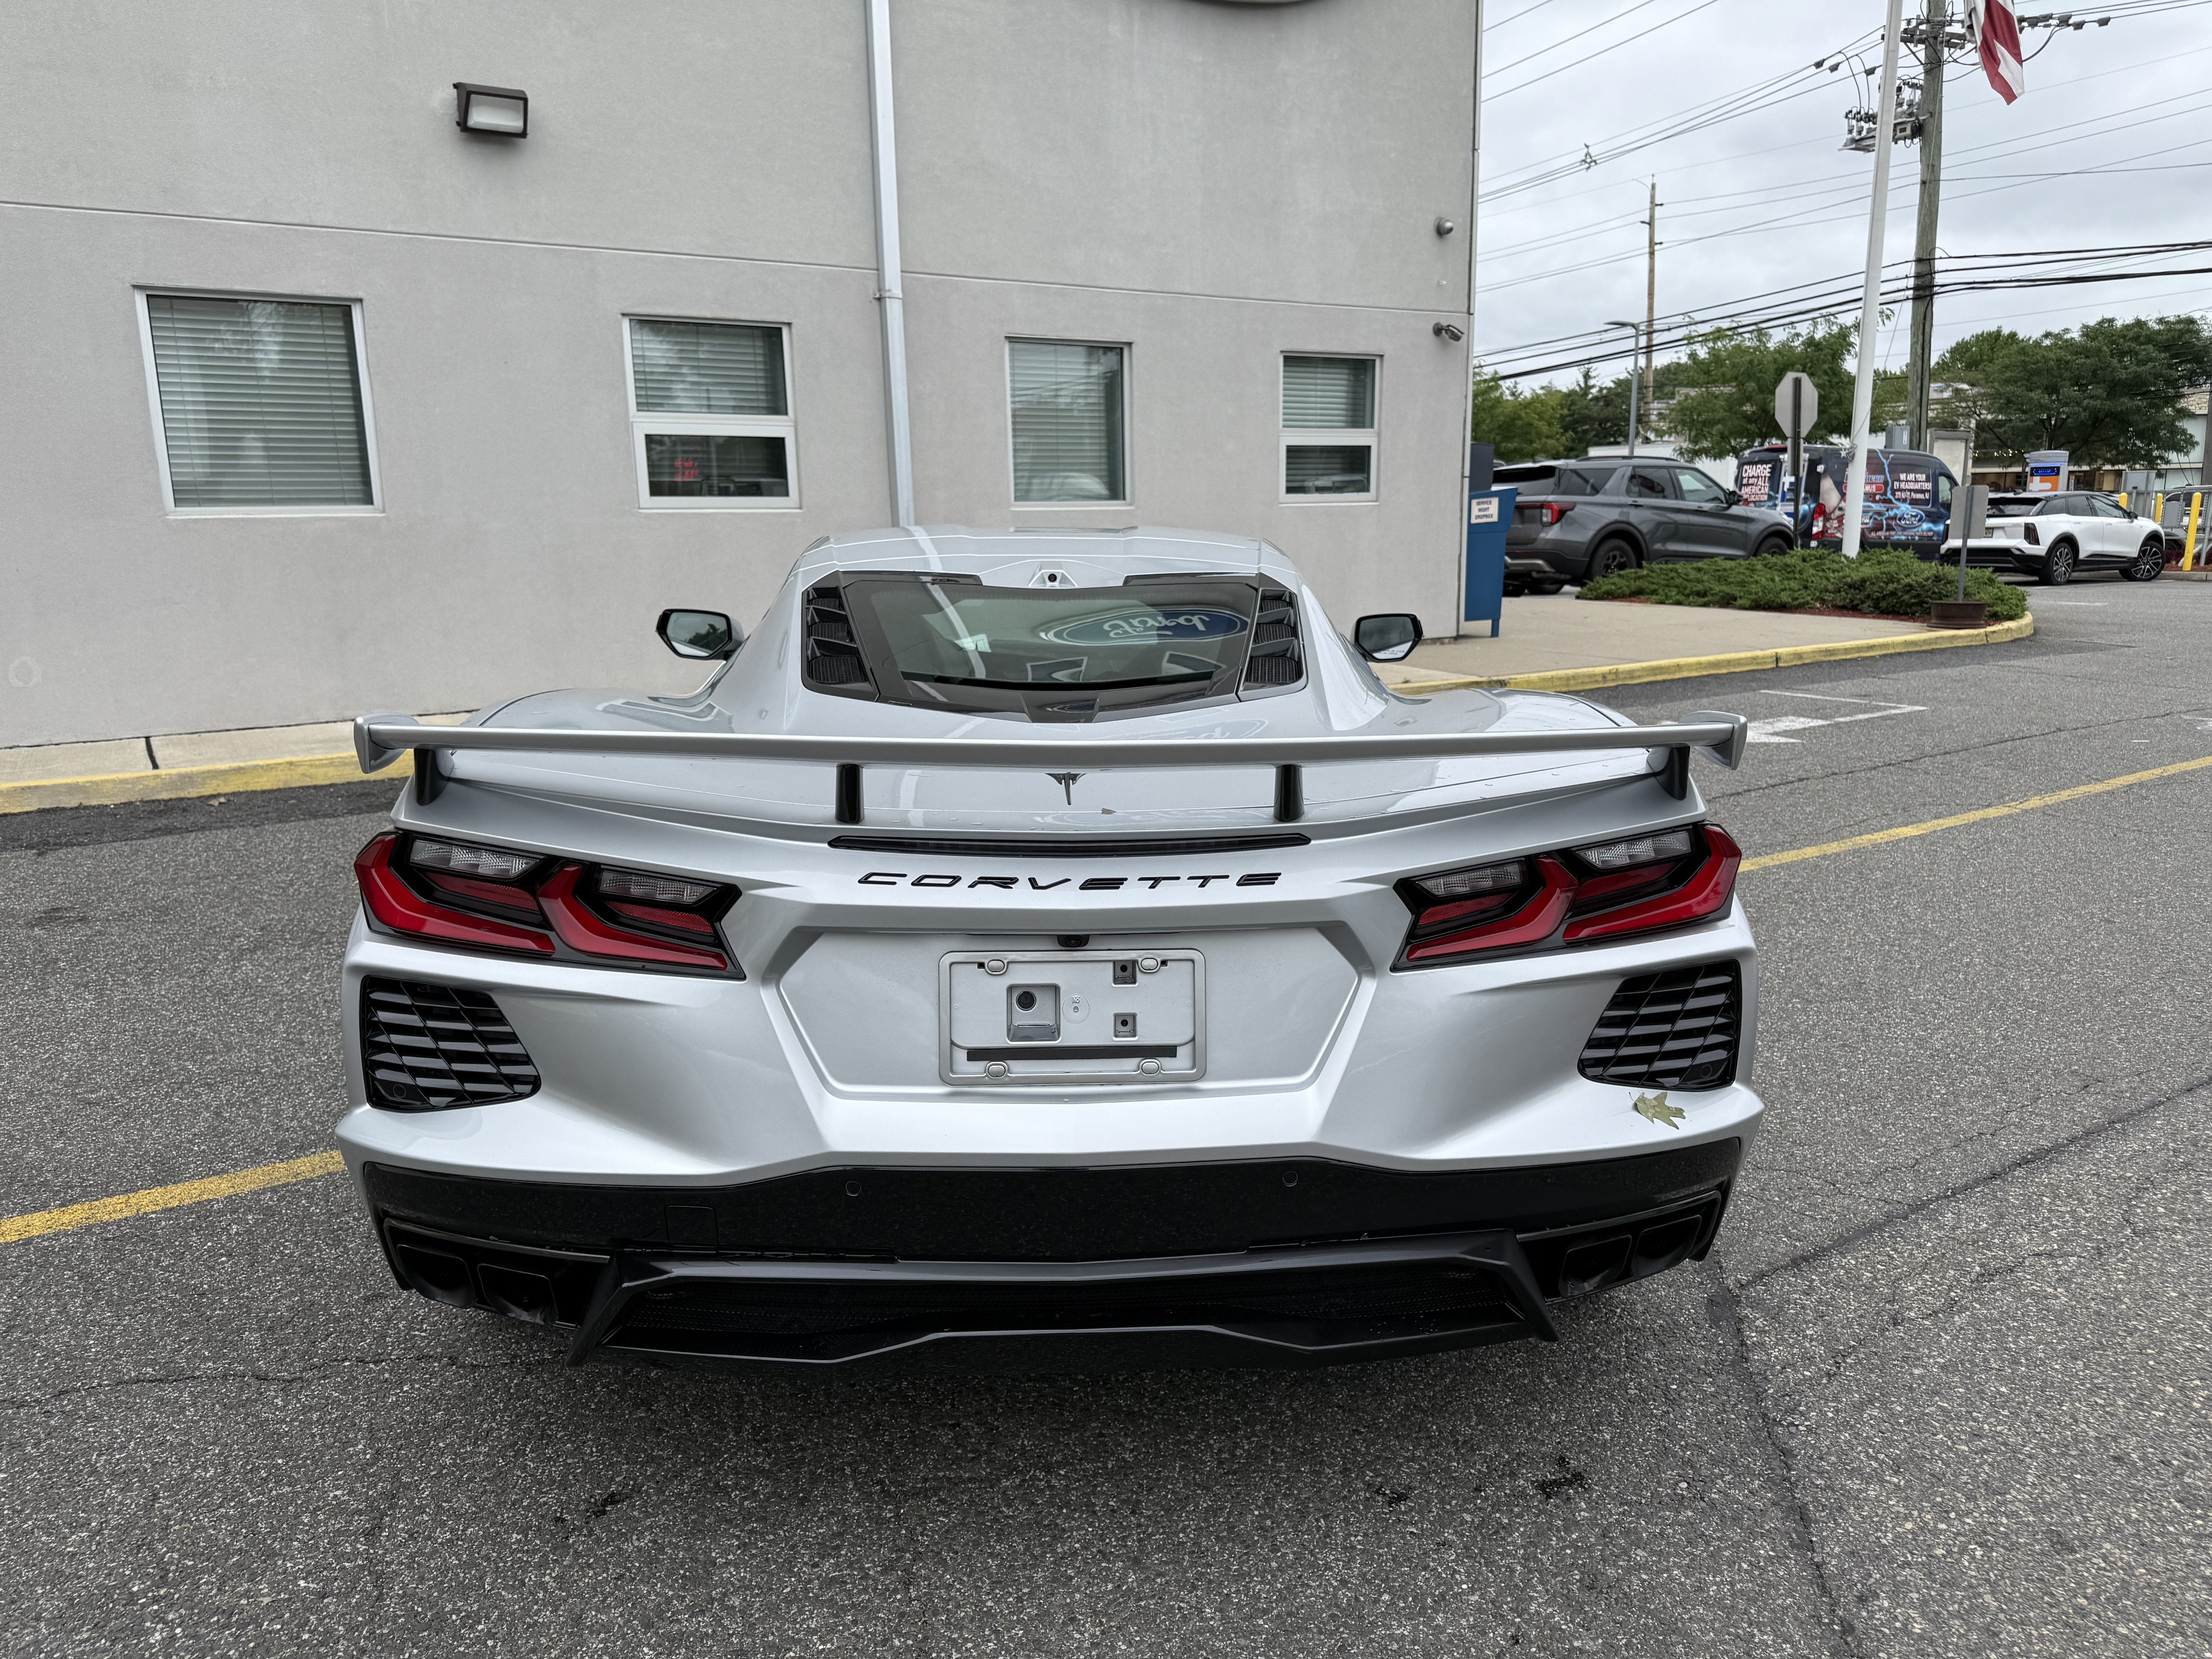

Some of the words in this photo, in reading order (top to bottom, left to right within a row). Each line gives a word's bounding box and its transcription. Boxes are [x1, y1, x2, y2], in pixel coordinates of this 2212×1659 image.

[1743, 464, 1772, 477] CHARGE
[1757, 477, 1769, 486] ALL
[1894, 481, 1899, 489] EV
[1741, 486, 1768, 495] AMERICAN
[1901, 512, 1920, 524] Ford
[858, 872, 1282, 890] CORVETTE
